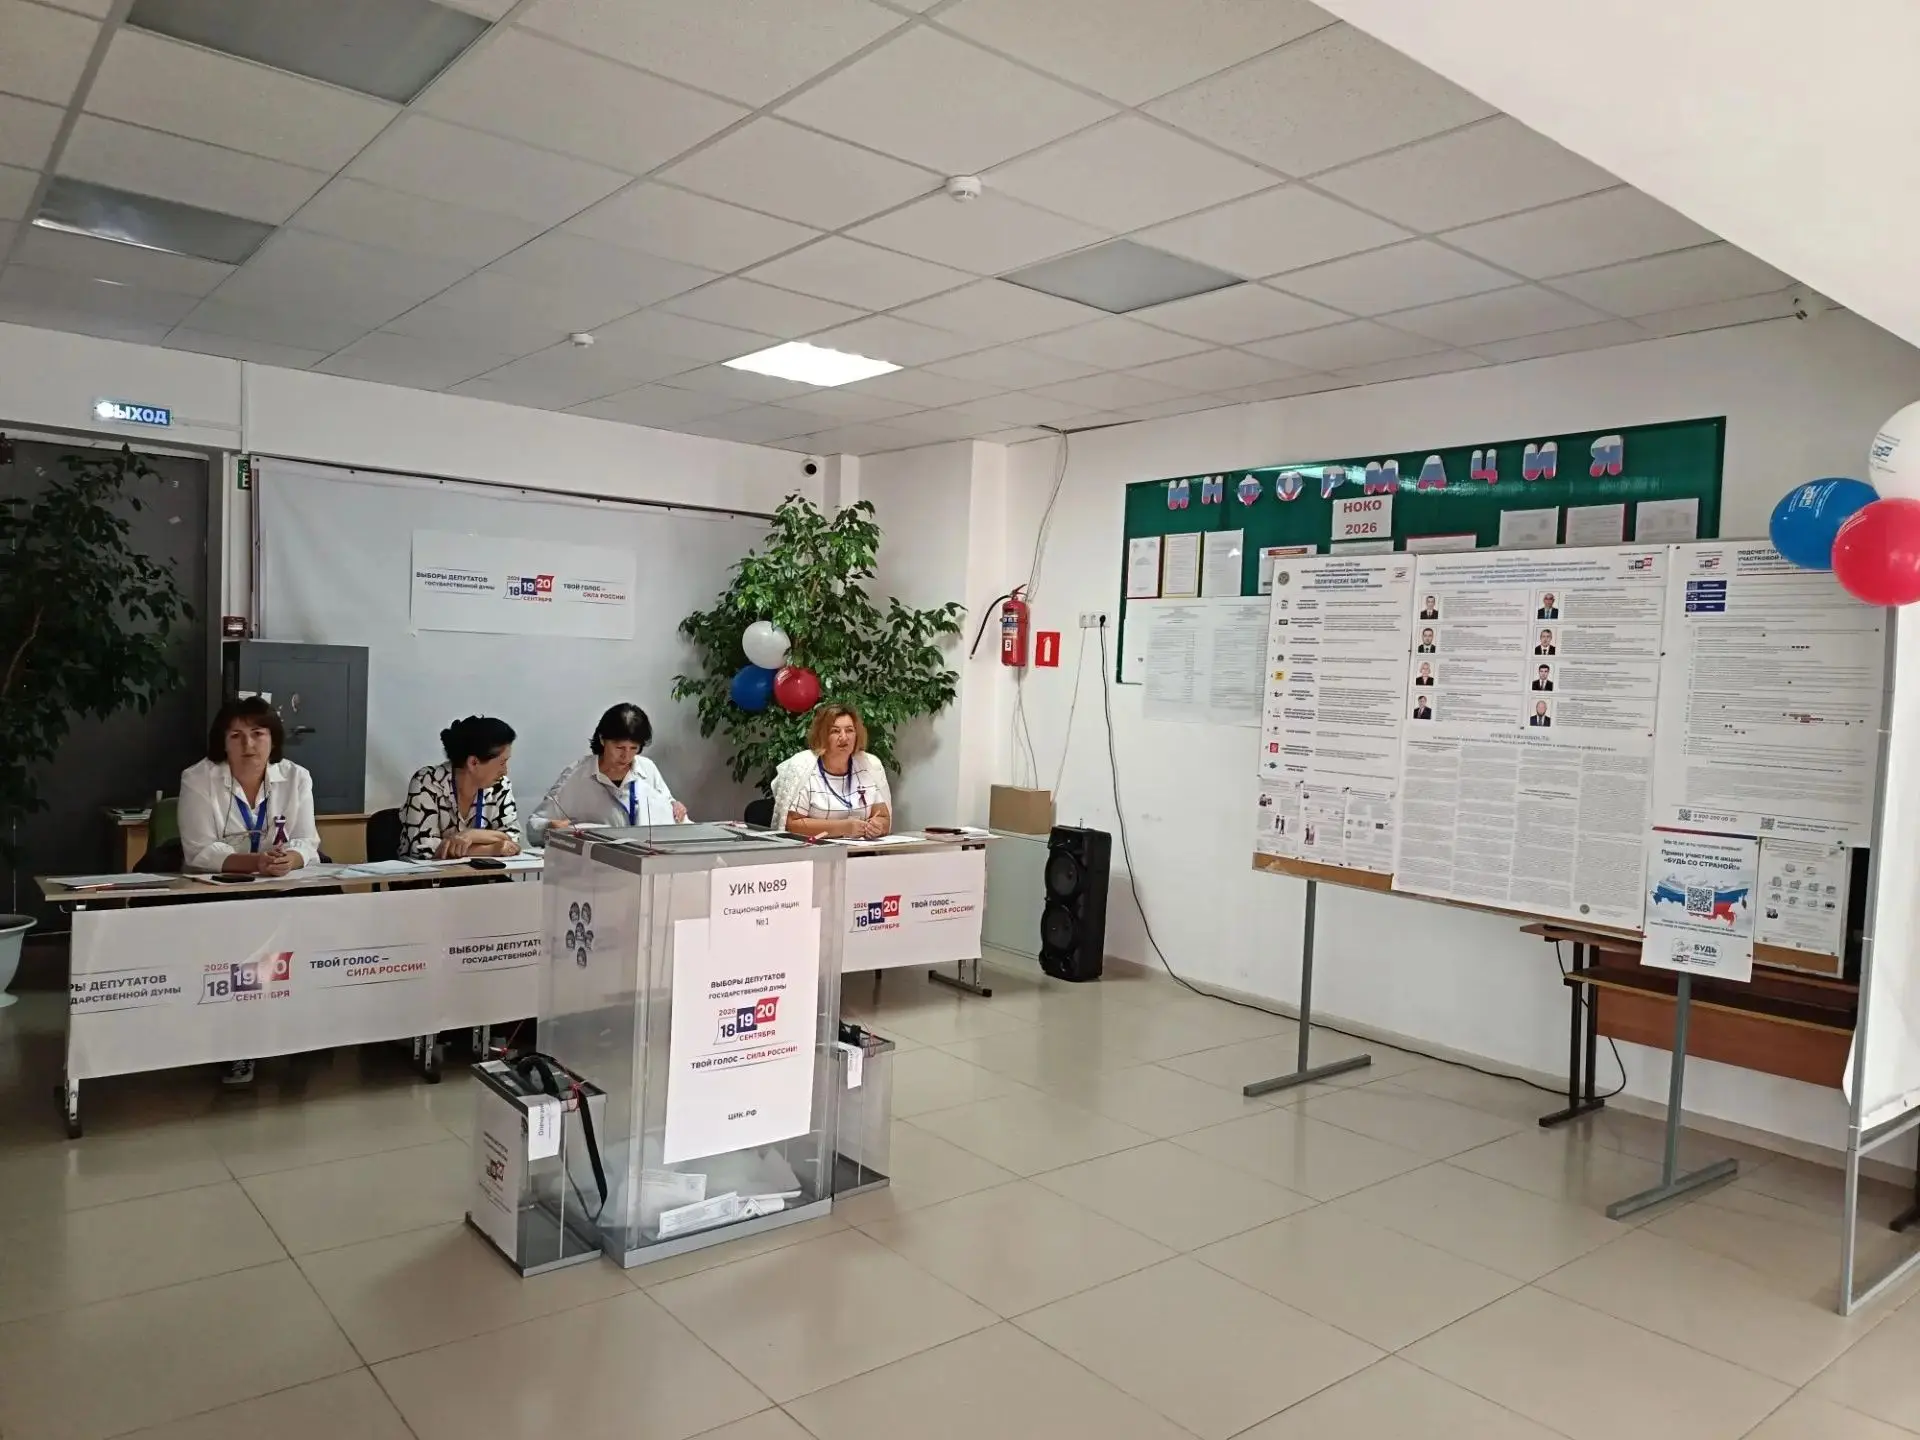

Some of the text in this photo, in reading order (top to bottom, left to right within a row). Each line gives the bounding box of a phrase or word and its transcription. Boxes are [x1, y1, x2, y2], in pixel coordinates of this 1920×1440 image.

[1168, 434, 1623, 510] ИНФОРМАЦИЯ
[1343, 500, 1382, 513] НОКО
[1345, 522, 1377, 535] 2026
[416, 572, 488, 583] ВЫБОРЫ ДЕПУТАТОВ
[425, 581, 478, 590] ГОСУДАРСТВЕННОЙ
[509, 578, 551, 596] 18 19 20
[564, 582, 580, 591] ТВОЙ
[729, 879, 787, 896] УИК №89
[723, 901, 800, 916] Стационарный ящик
[911, 900, 928, 909] ТВОЙ
[929, 899, 950, 907] ГОЛОС
[856, 901, 898, 927] 18 19 20
[930, 908, 947, 916] СИЛА
[870, 923, 900, 931] СЕНТЯБРЯ
[449, 943, 494, 955] ВЫБОРЫ
[310, 957, 340, 969] ТВОЙ
[343, 955, 379, 967] ГОЛОС
[462, 950, 537, 965] ГОСУДАРСТВЕННОЙ
[204, 963, 229, 972] 2026
[347, 963, 427, 978] СИЛА РОССИИ!
[89, 975, 167, 991] ДЕПУТАТОВ
[207, 980, 229, 997] 18
[234, 965, 255, 987] 19
[710, 972, 786, 989] ВЫБОРЫ ДЕПУТАТОВ
[151, 986, 181, 997] ДУМЫ
[236, 990, 290, 1002] СЕНТБРЯ
[709, 984, 787, 1000] ГОСУДАРСТВЕННОЙ ДУМЫ
[719, 1008, 736, 1016] 2026
[720, 1003, 774, 1038] 18 19 20
[739, 1030, 776, 1041] СЕНТЯБРЯ
[691, 1059, 712, 1069] ТВОЙ
[713, 1056, 739, 1066] ГОЛОС
[746, 1051, 766, 1061] СИЛА
[767, 1046, 798, 1057] РОССИИ!
[728, 1109, 757, 1120] ЦИК.РФ
